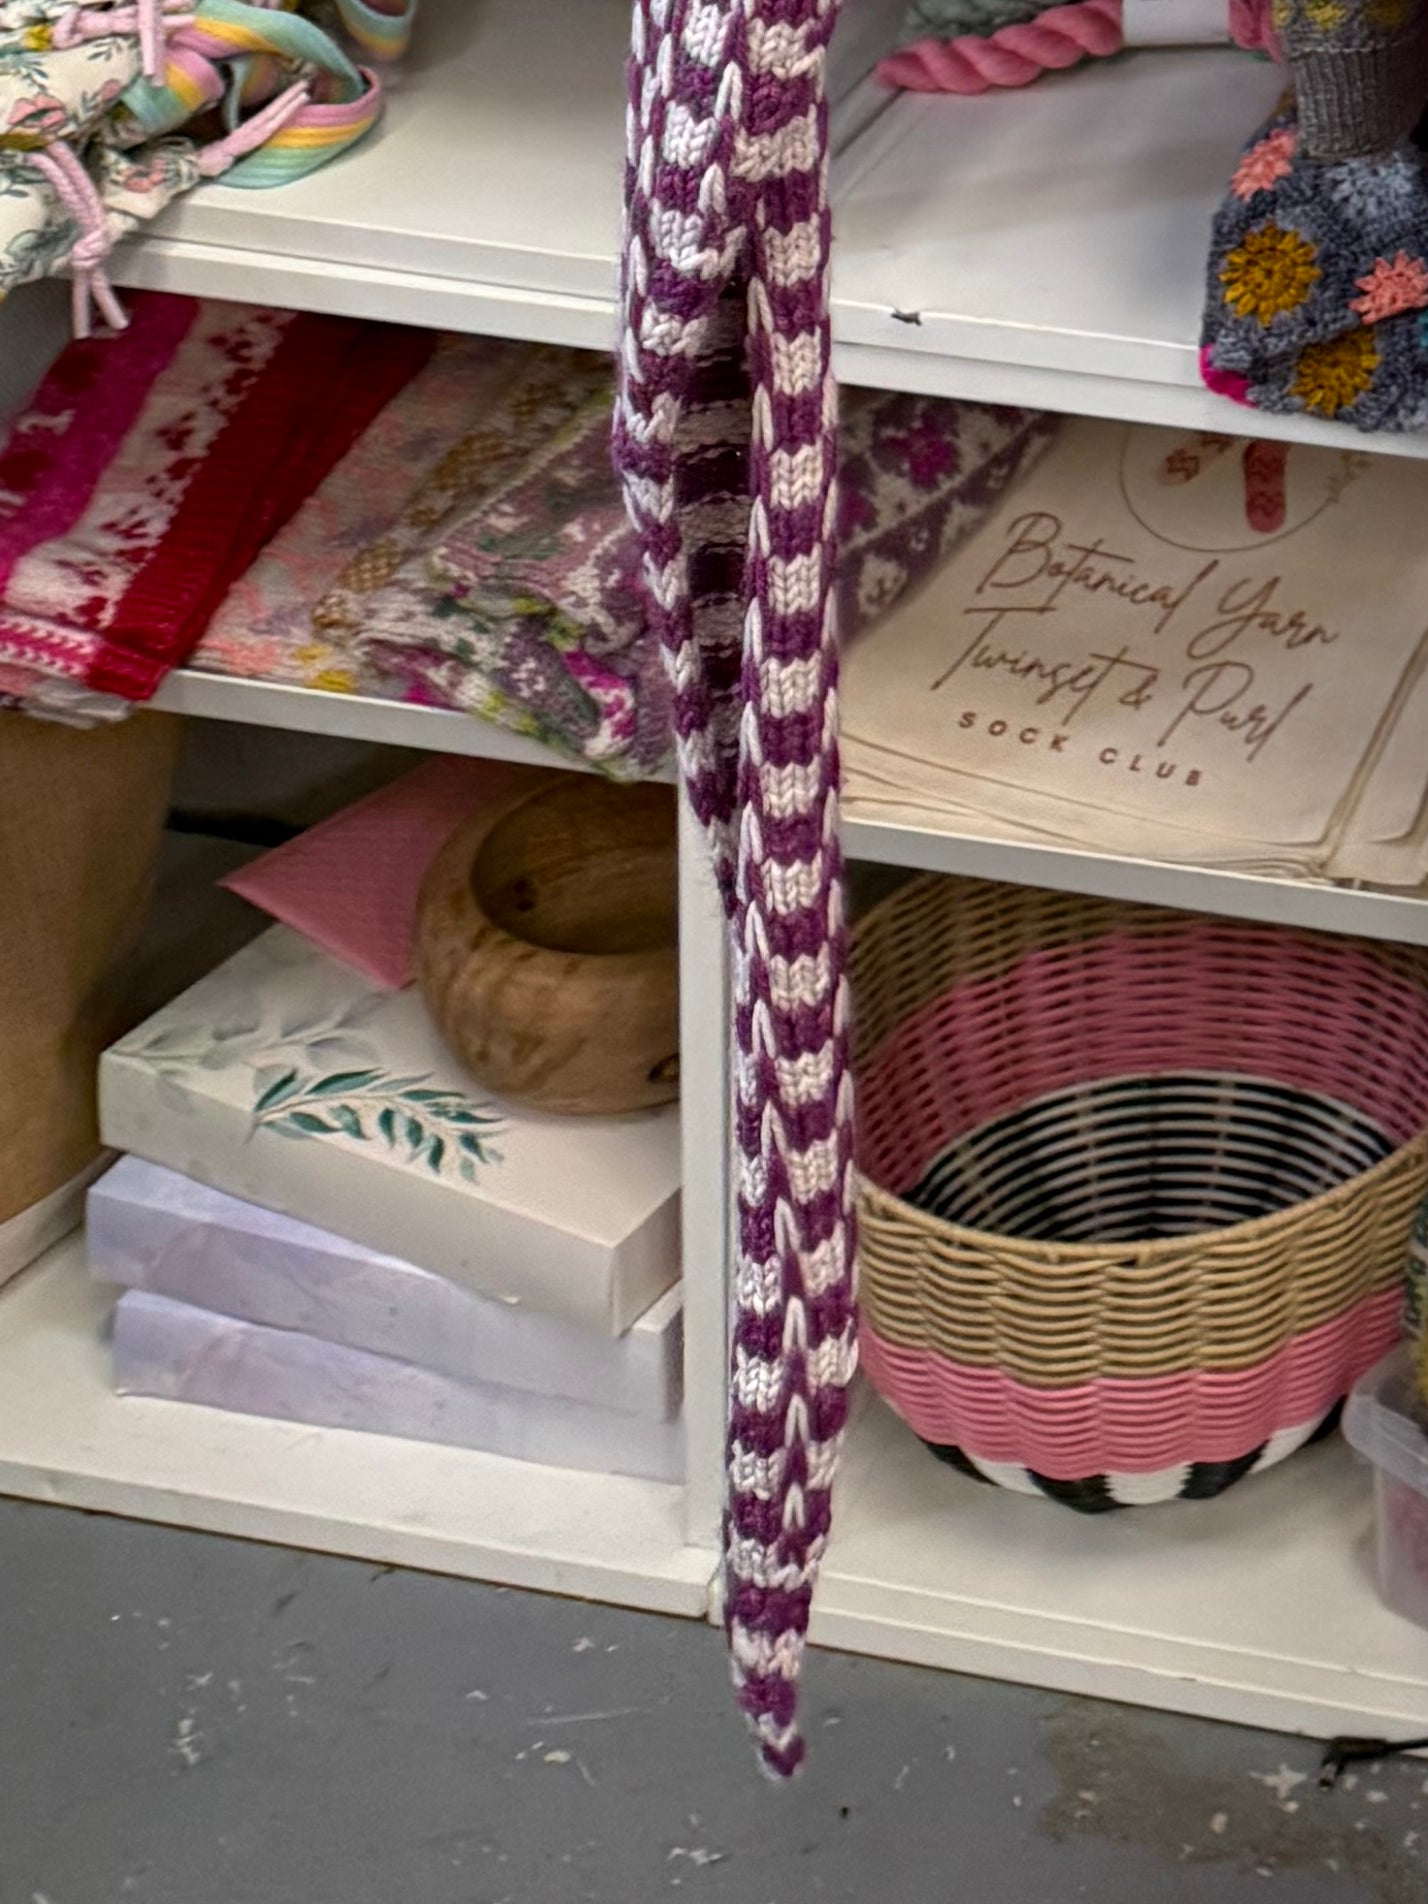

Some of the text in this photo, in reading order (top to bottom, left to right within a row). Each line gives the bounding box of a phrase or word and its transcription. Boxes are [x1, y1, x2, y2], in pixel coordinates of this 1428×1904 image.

[976, 512, 1339, 660] Botanical Yarn
[931, 606, 1313, 762] Twinset & Purl
[958, 711, 1205, 787] SOCK CLUB
